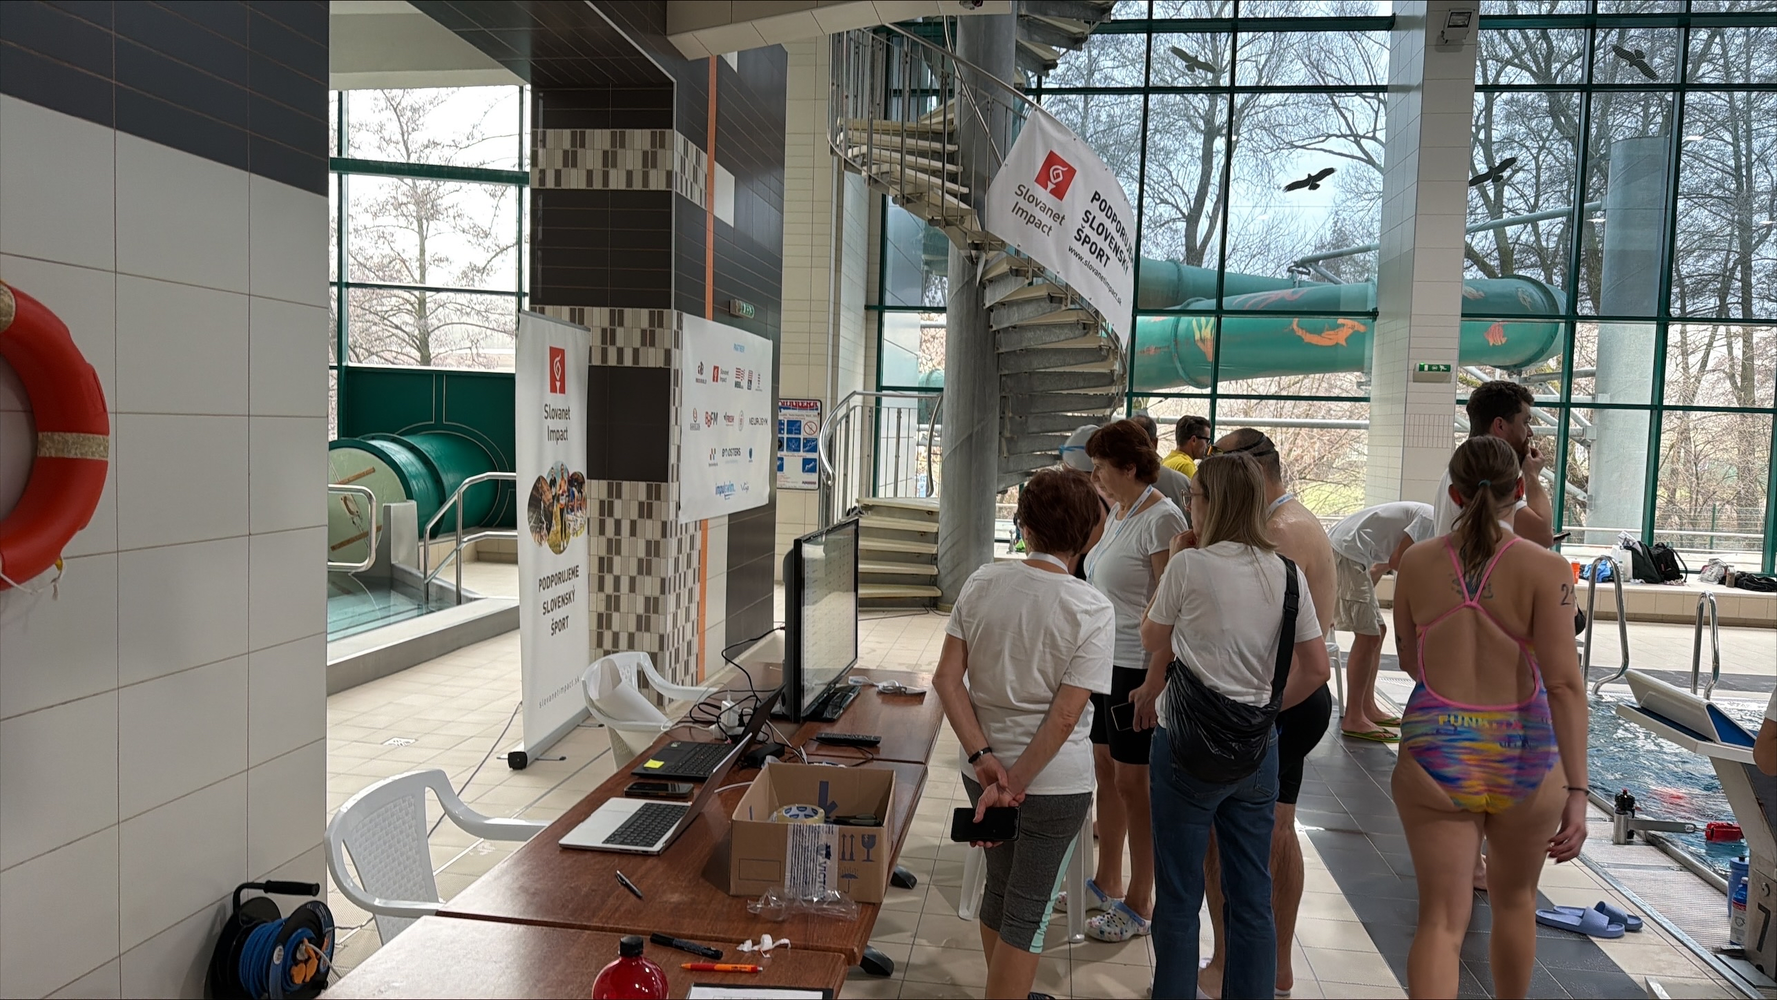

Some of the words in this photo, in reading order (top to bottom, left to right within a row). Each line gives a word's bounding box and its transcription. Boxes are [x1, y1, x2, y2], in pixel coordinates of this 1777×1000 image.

[1011, 201, 1053, 237] Impact
[1015, 184, 1066, 226] Slovanet
[1073, 223, 1111, 268] ŠPORT
[1082, 209, 1129, 276] SLOVENSKÝ
[543, 403, 571, 421] Slovanet
[547, 425, 569, 446] Impact
[538, 565, 579, 593] PODPORUJEME
[542, 585, 576, 616] SLOVENSKÝ
[551, 615, 570, 637] ŠPORT
[1756, 902, 1771, 953] 7
